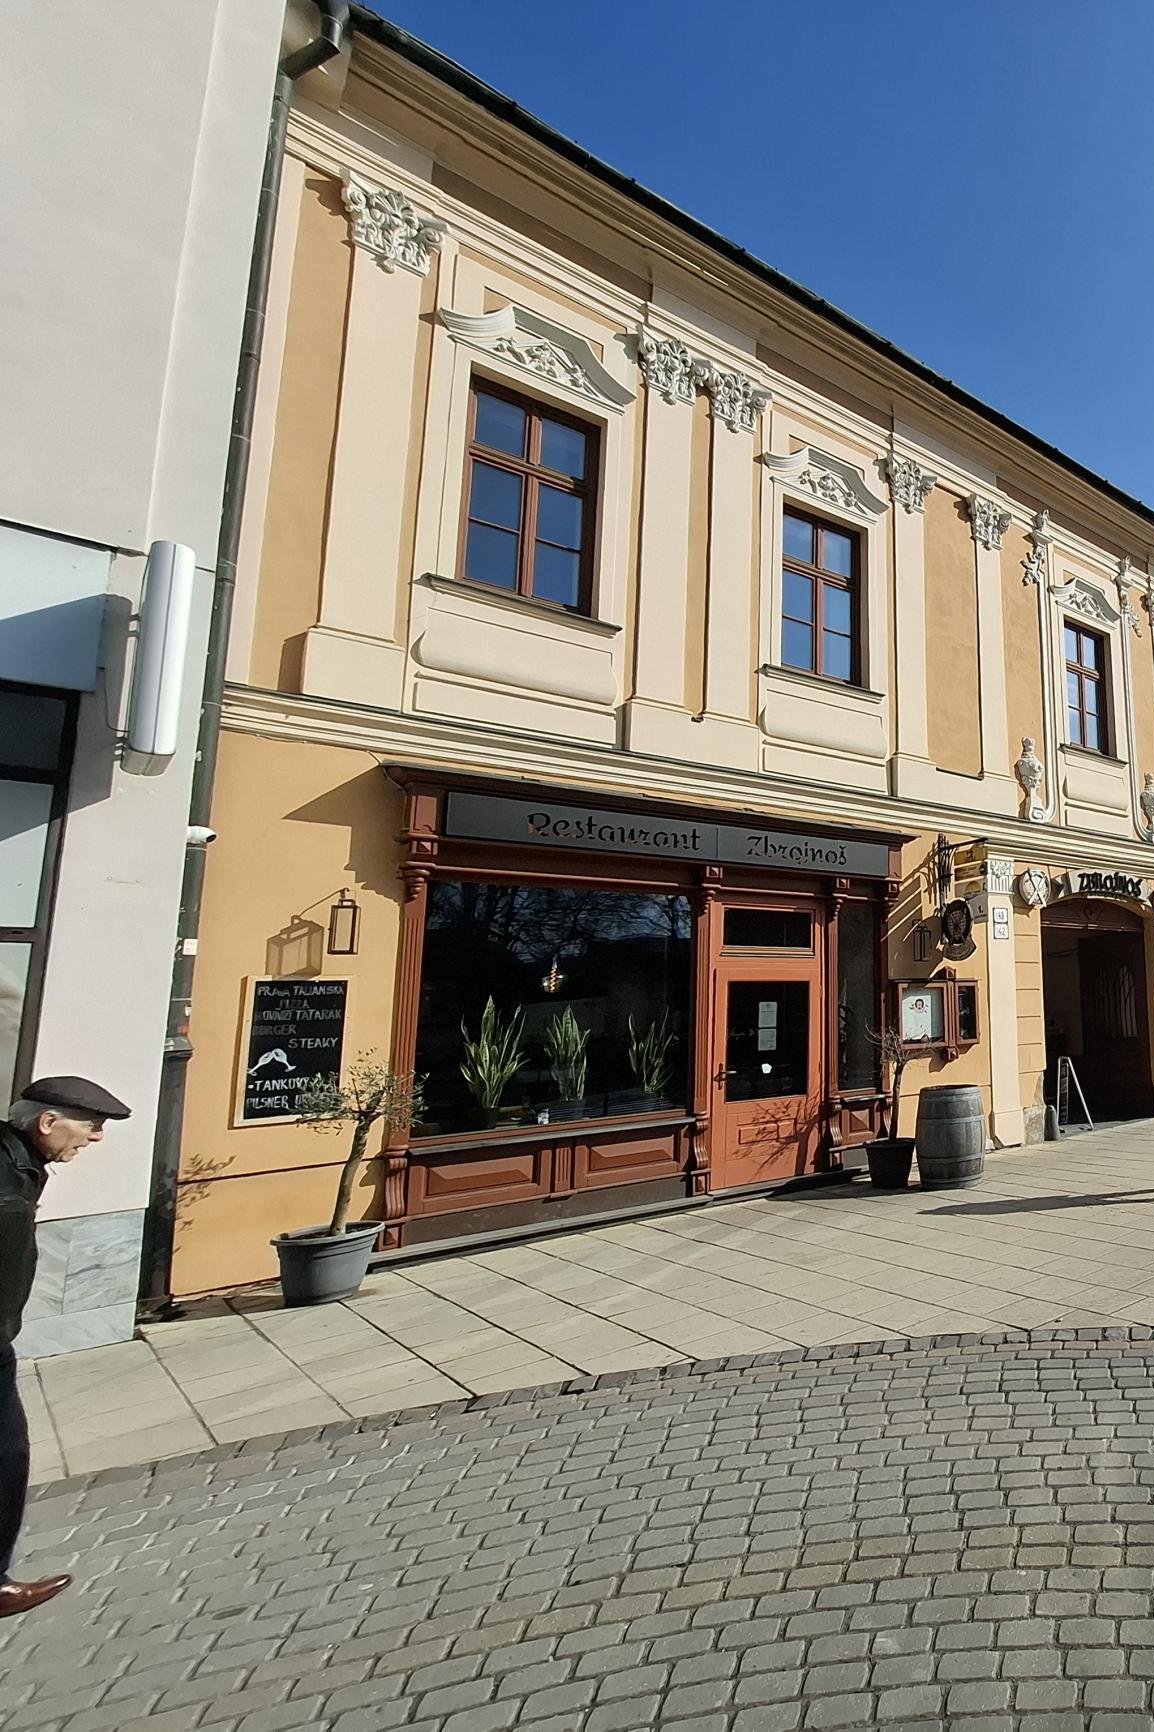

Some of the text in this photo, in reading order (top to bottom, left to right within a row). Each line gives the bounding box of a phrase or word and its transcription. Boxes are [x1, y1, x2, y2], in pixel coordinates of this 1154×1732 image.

[526, 811, 701, 852] Restaurant
[287, 1036, 339, 1049] STEAKY
[246, 1094, 290, 1110] PILSNER
